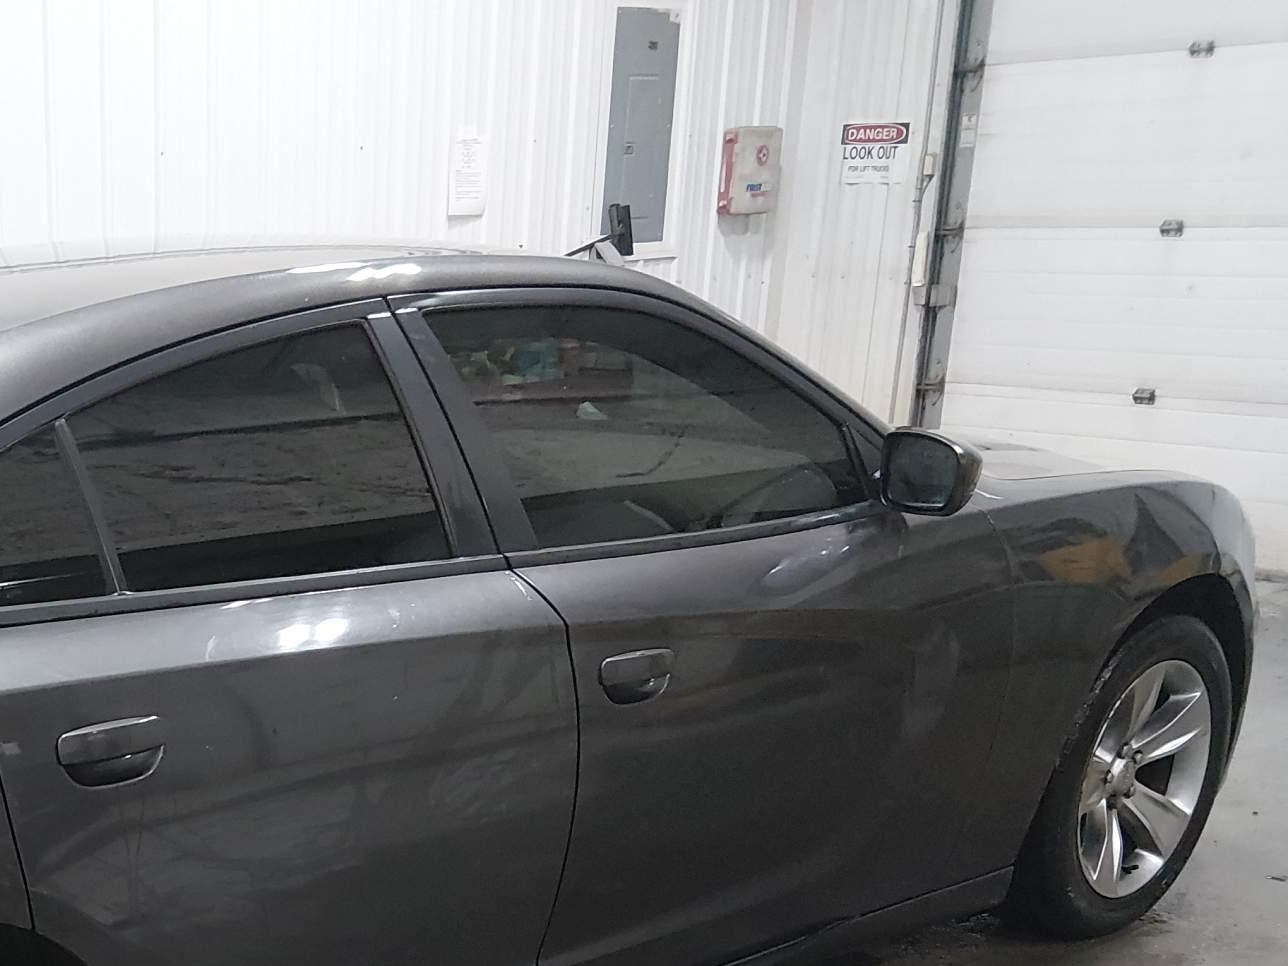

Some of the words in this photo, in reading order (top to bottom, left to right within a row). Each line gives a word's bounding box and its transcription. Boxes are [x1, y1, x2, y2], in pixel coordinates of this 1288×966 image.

[848, 128, 898, 141] DANGER
[843, 146, 874, 160] LOOK
[877, 145, 899, 160] OUT
